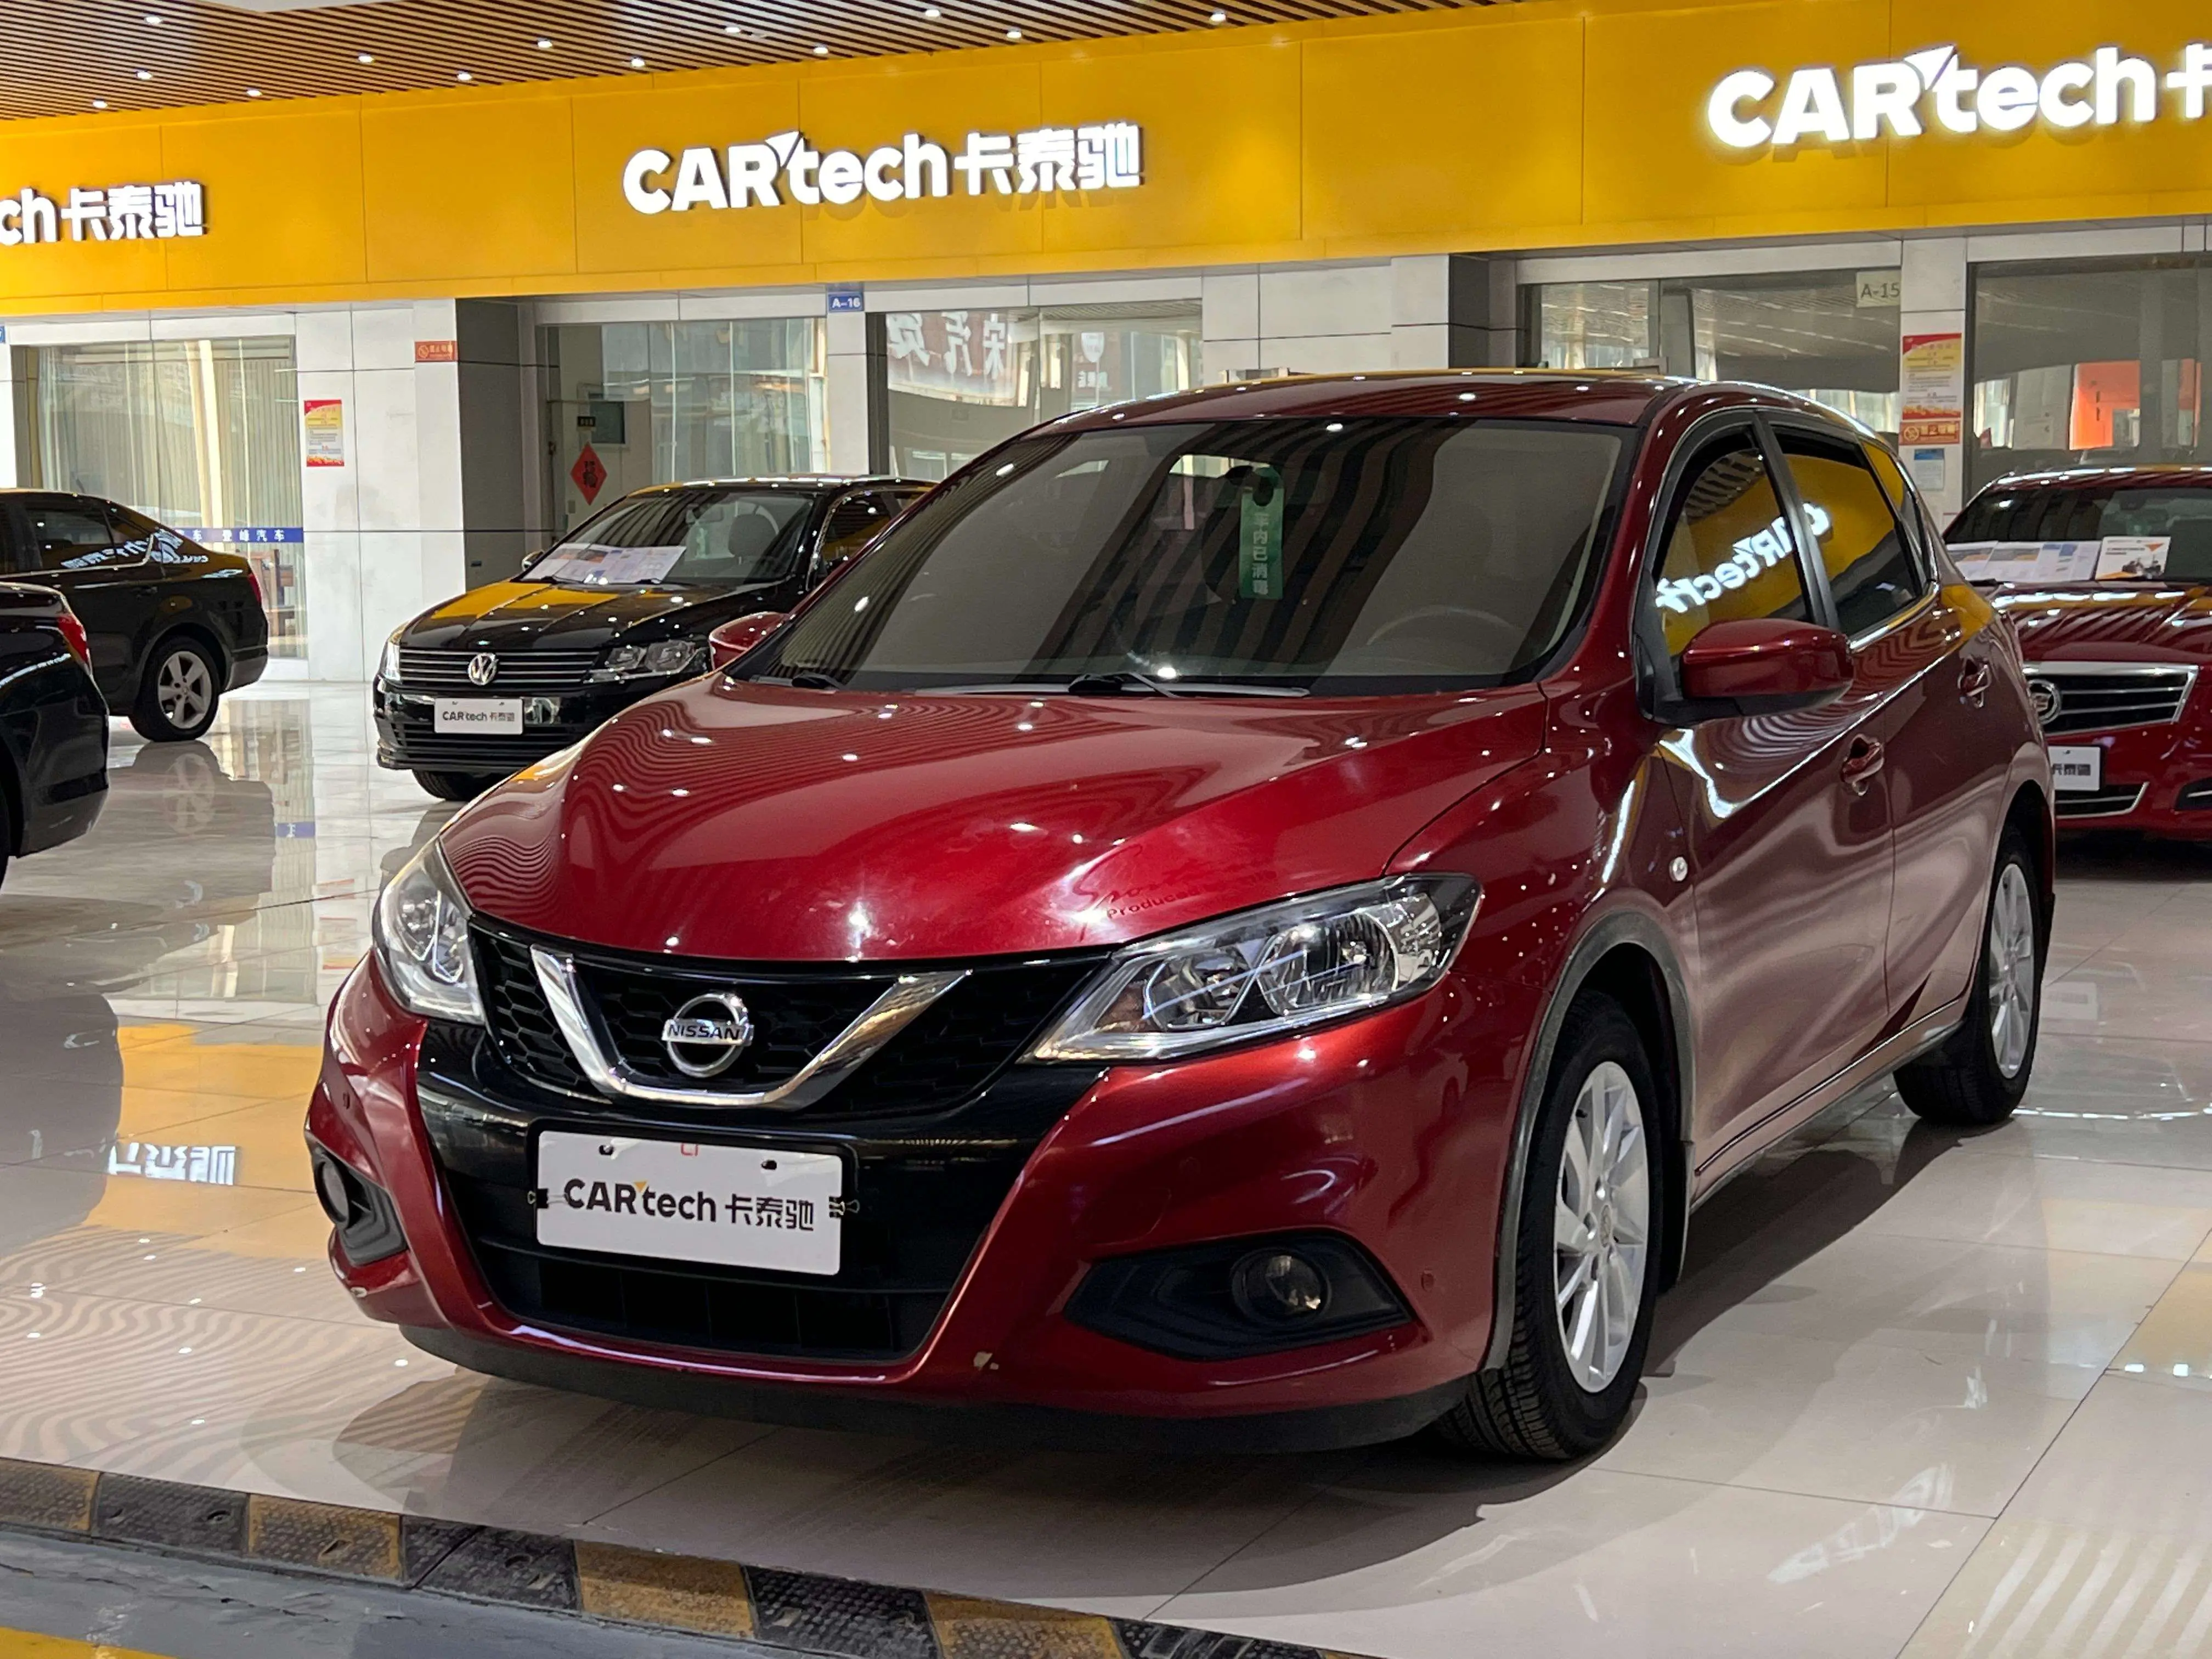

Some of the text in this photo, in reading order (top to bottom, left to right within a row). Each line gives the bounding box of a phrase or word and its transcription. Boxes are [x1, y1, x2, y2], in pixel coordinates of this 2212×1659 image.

[1708, 45, 2157, 147] CARtech
[623, 121, 1141, 214] CARtech 卡泰驰
[61, 180, 204, 241] 卡泰驰
[832, 297, 861, 308] A-16
[1861, 283, 1900, 298] A-15
[442, 710, 487, 721] CARtech
[668, 1024, 741, 1040] NISSAN
[563, 1178, 815, 1231] CARtech 卡泰驰
